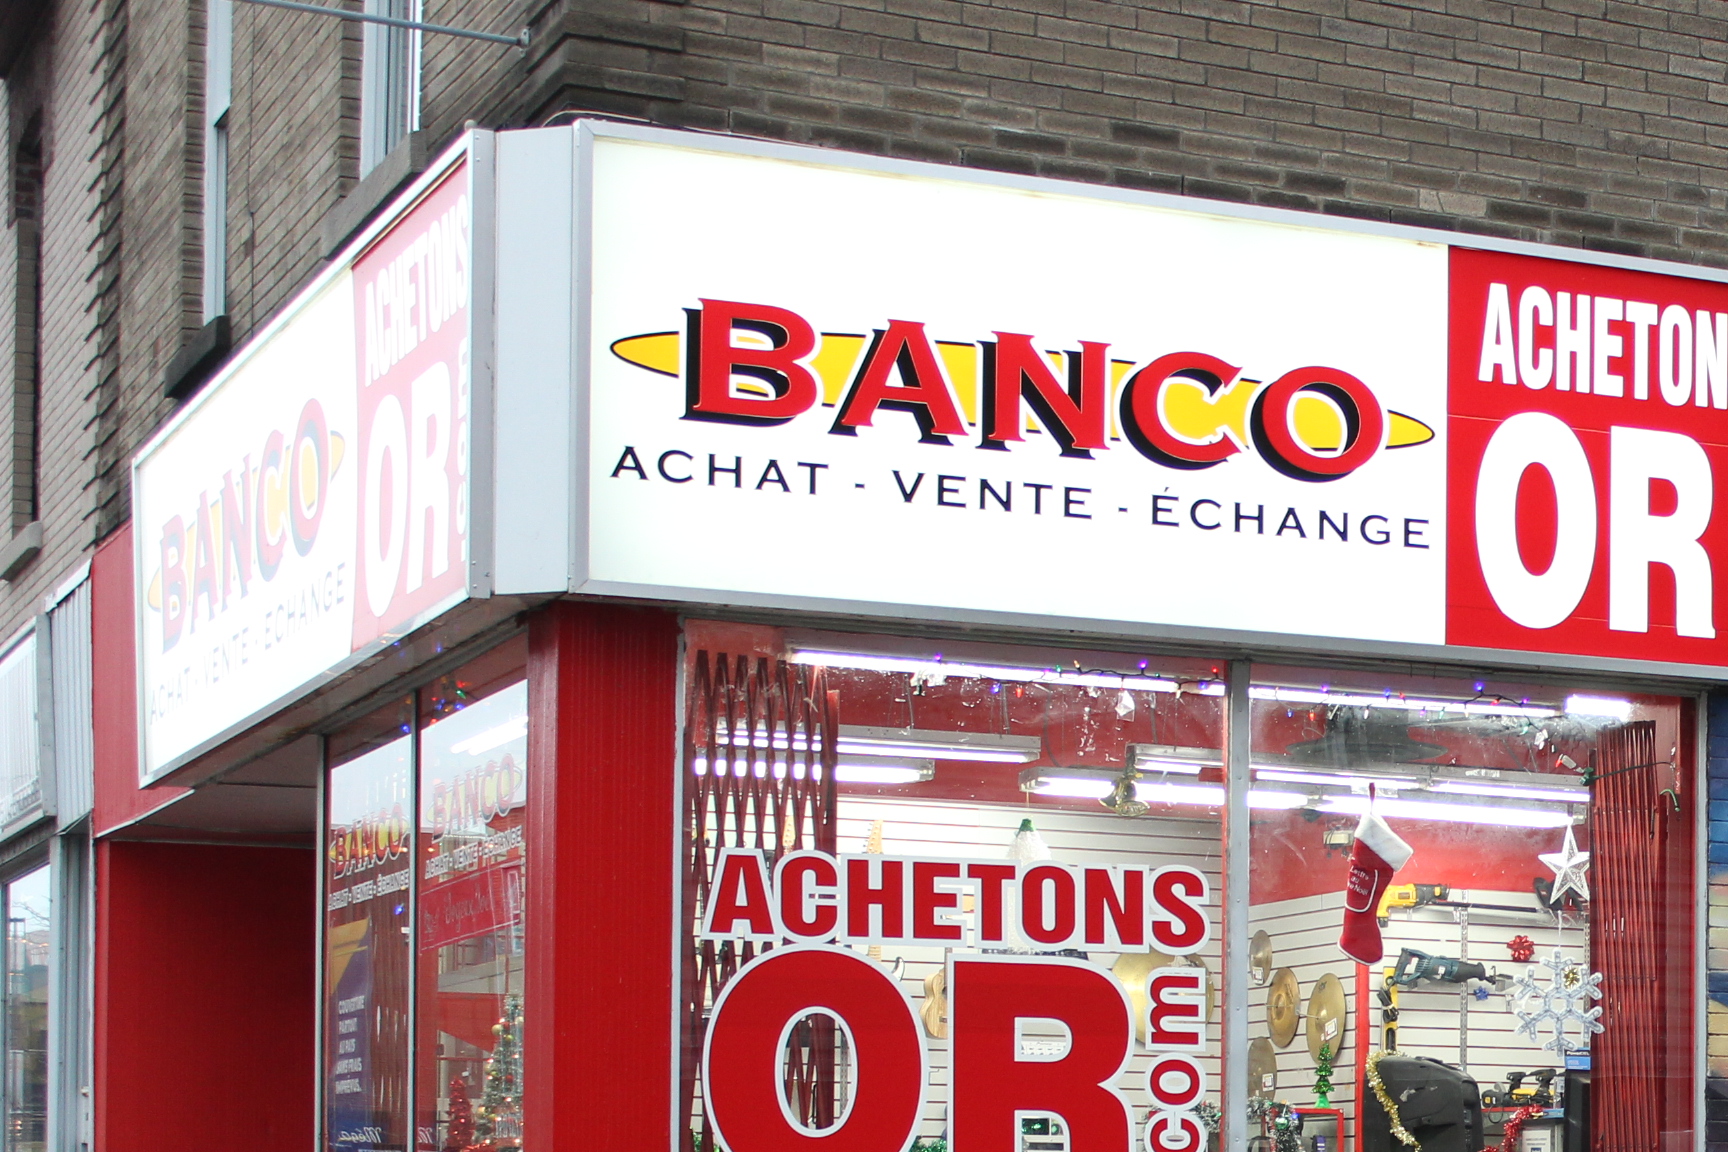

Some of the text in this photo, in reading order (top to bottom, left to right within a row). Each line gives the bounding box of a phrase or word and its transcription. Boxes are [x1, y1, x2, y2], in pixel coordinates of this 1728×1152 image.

[364, 193, 468, 387] ACHETONS
[678, 297, 1385, 483] BANCO
[155, 397, 331, 655] BANCO
[364, 360, 453, 618] OR
[611, 445, 830, 496] ACHAT
[891, 469, 1093, 520] VENTE
[1150, 486, 1431, 550] ÉCHANGE
[1474, 411, 1717, 640] OR
[150, 665, 191, 726] ACHAT
[203, 626, 250, 688] VENTE
[334, 802, 406, 880] BANCO
[432, 753, 515, 845] BANCO
[703, 848, 1210, 954] ACHETONS
